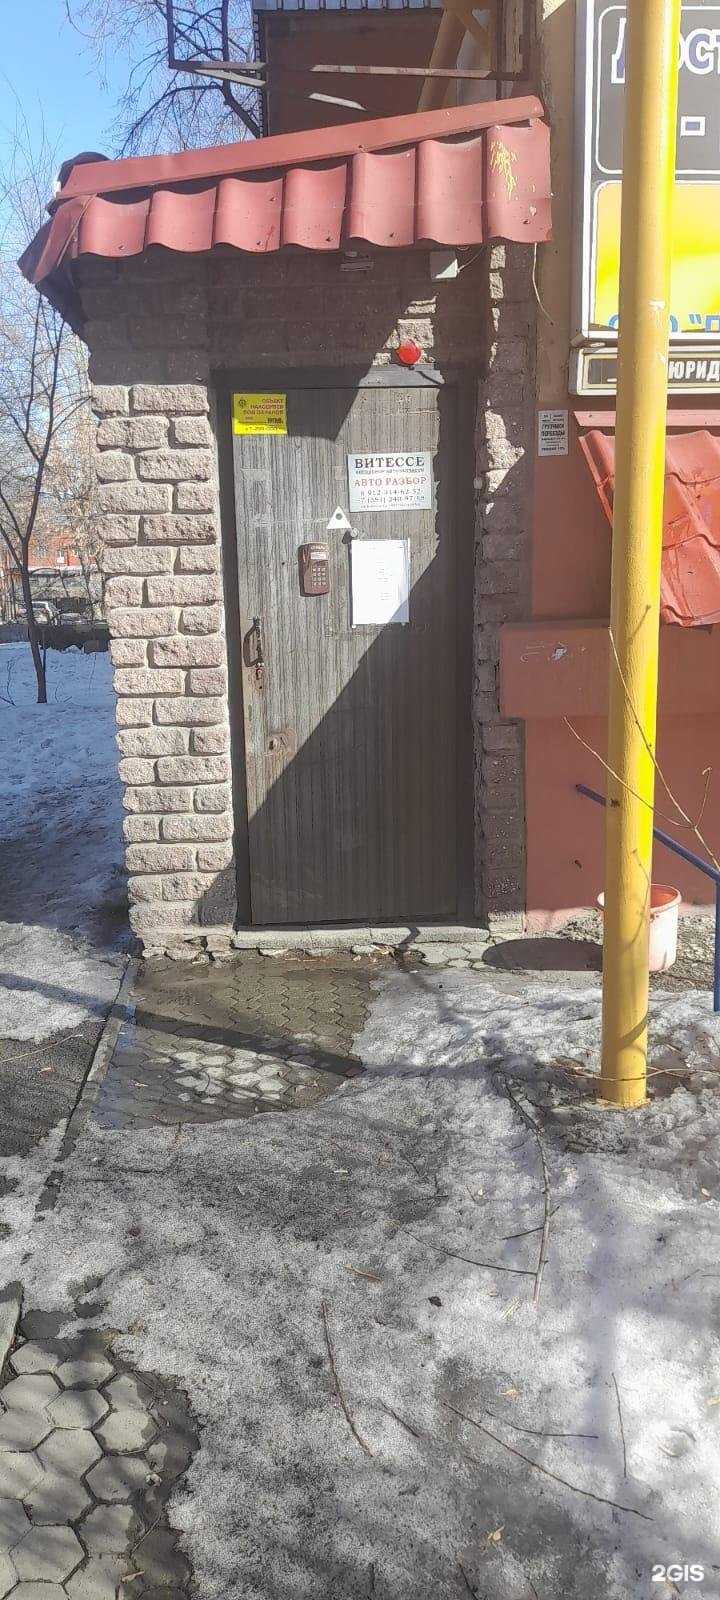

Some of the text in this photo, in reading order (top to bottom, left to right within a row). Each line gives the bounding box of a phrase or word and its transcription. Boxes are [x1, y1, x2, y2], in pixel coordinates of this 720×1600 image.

[354, 456, 425, 469] ВИТЕССЕ
[354, 476, 427, 487] АВТО РАЗБОР
